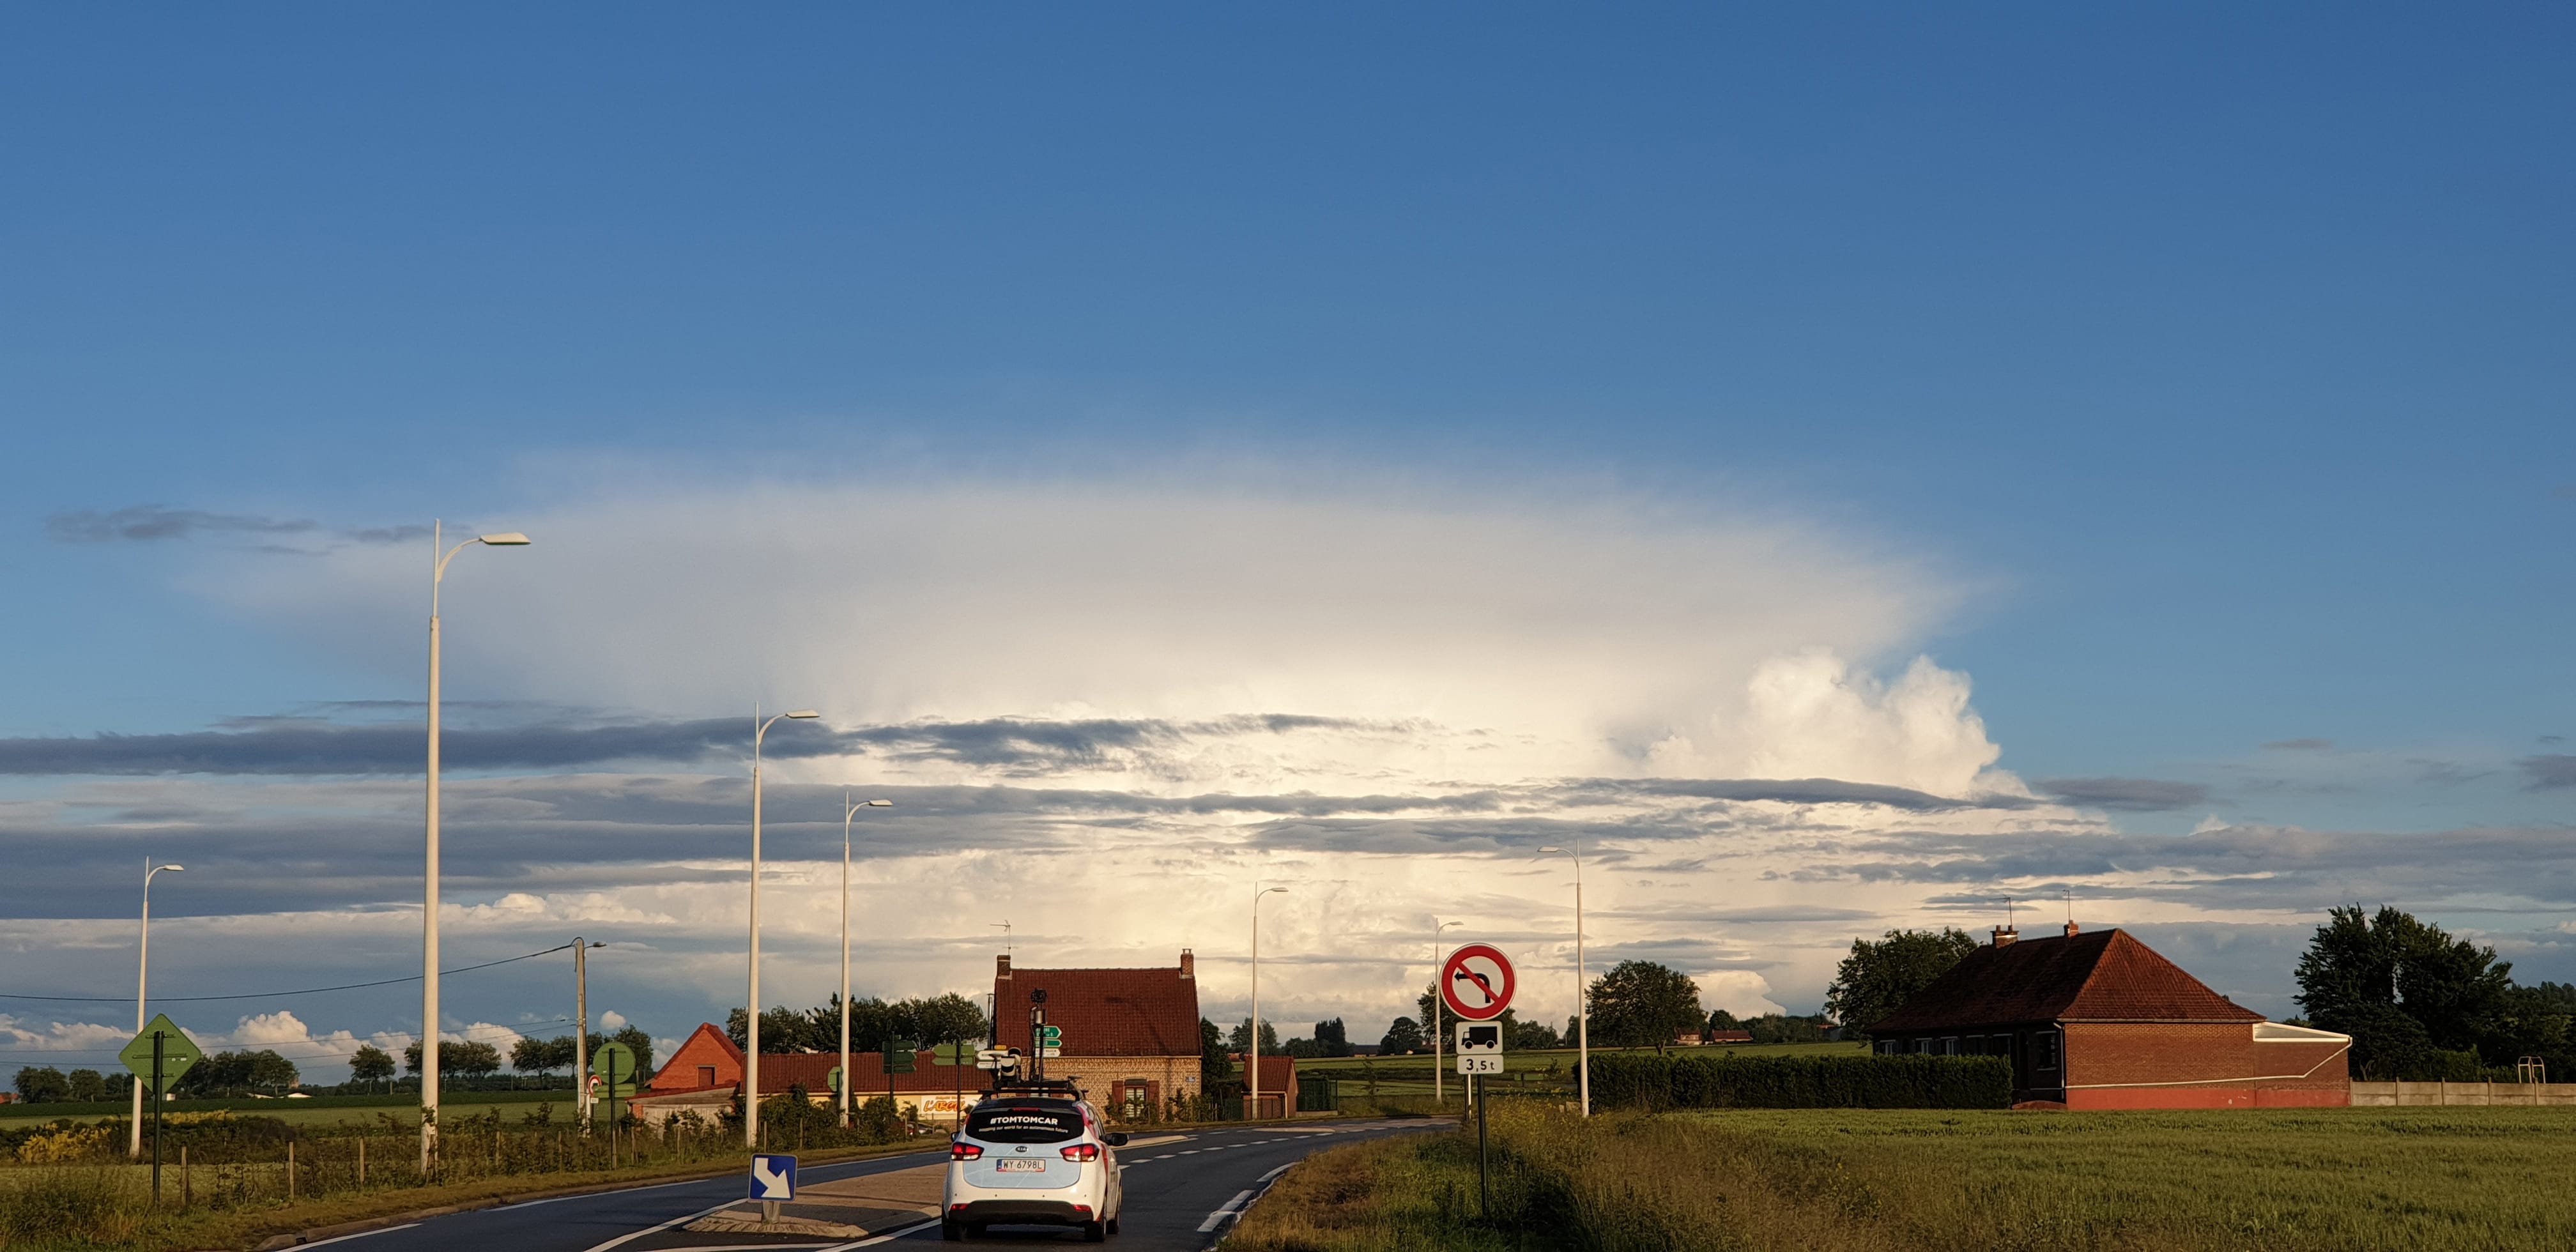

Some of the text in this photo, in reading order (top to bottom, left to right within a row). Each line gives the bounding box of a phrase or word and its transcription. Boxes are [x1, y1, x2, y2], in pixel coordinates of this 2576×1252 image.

[990, 1116, 1058, 1125] #TOMTOMCAR
[1003, 1160, 1042, 1169] WY 6798L
